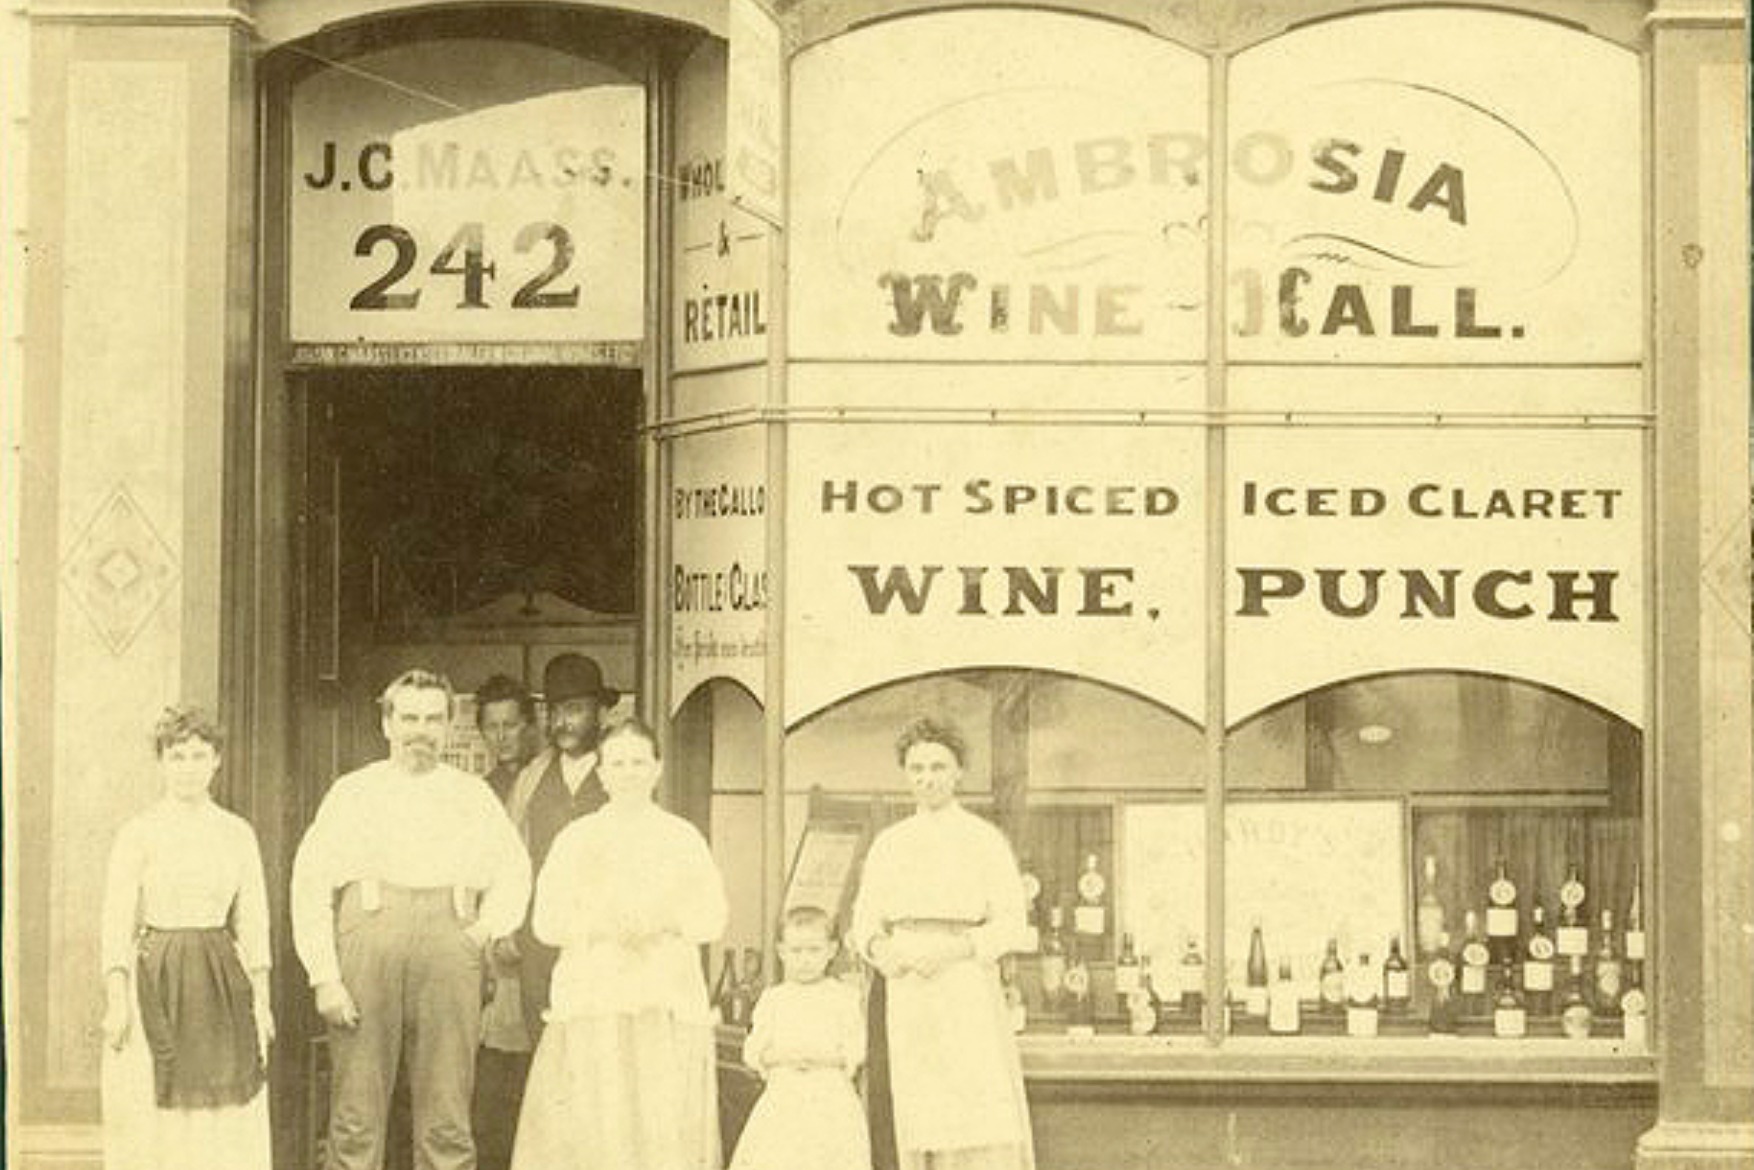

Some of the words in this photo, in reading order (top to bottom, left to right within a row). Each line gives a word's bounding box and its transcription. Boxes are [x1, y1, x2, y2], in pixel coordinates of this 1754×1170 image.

[910, 132, 1468, 243] AMBROSIA
[350, 224, 581, 311] 242
[685, 291, 767, 342] RETAIL
[877, 269, 1142, 337] WINE
[822, 480, 941, 514] HOT
[965, 480, 1180, 517] SPICED
[1243, 482, 1387, 518] ICED
[1408, 483, 1623, 519] CLARET
[1235, 567, 1621, 622] PUNCH
